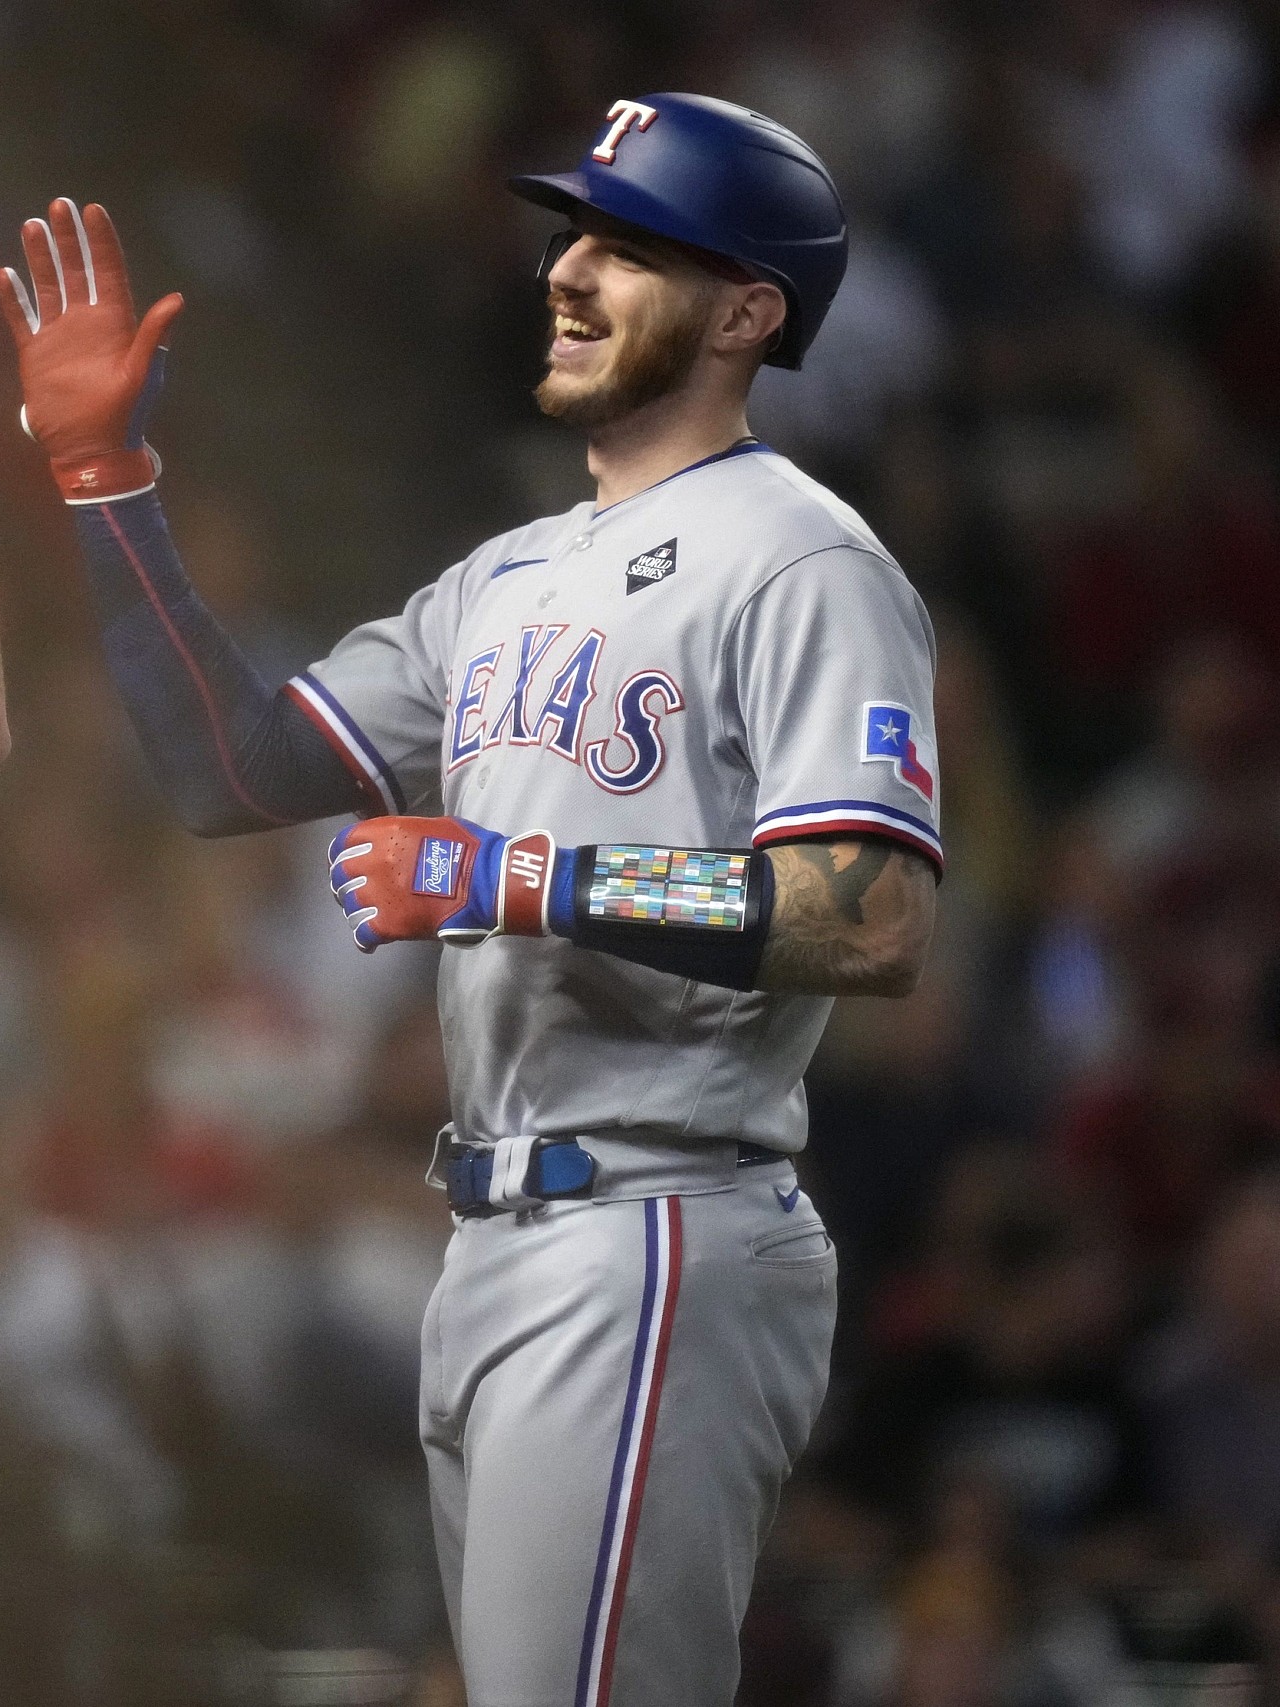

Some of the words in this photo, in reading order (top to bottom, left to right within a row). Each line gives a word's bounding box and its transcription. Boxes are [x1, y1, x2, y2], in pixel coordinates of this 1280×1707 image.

[592, 99, 658, 166] T
[627, 565, 666, 580] SERIES
[637, 555, 673, 570] WORLD
[446, 624, 685, 796] EXAS
[425, 840, 448, 893] Rawlings
[511, 849, 545, 890] JH
